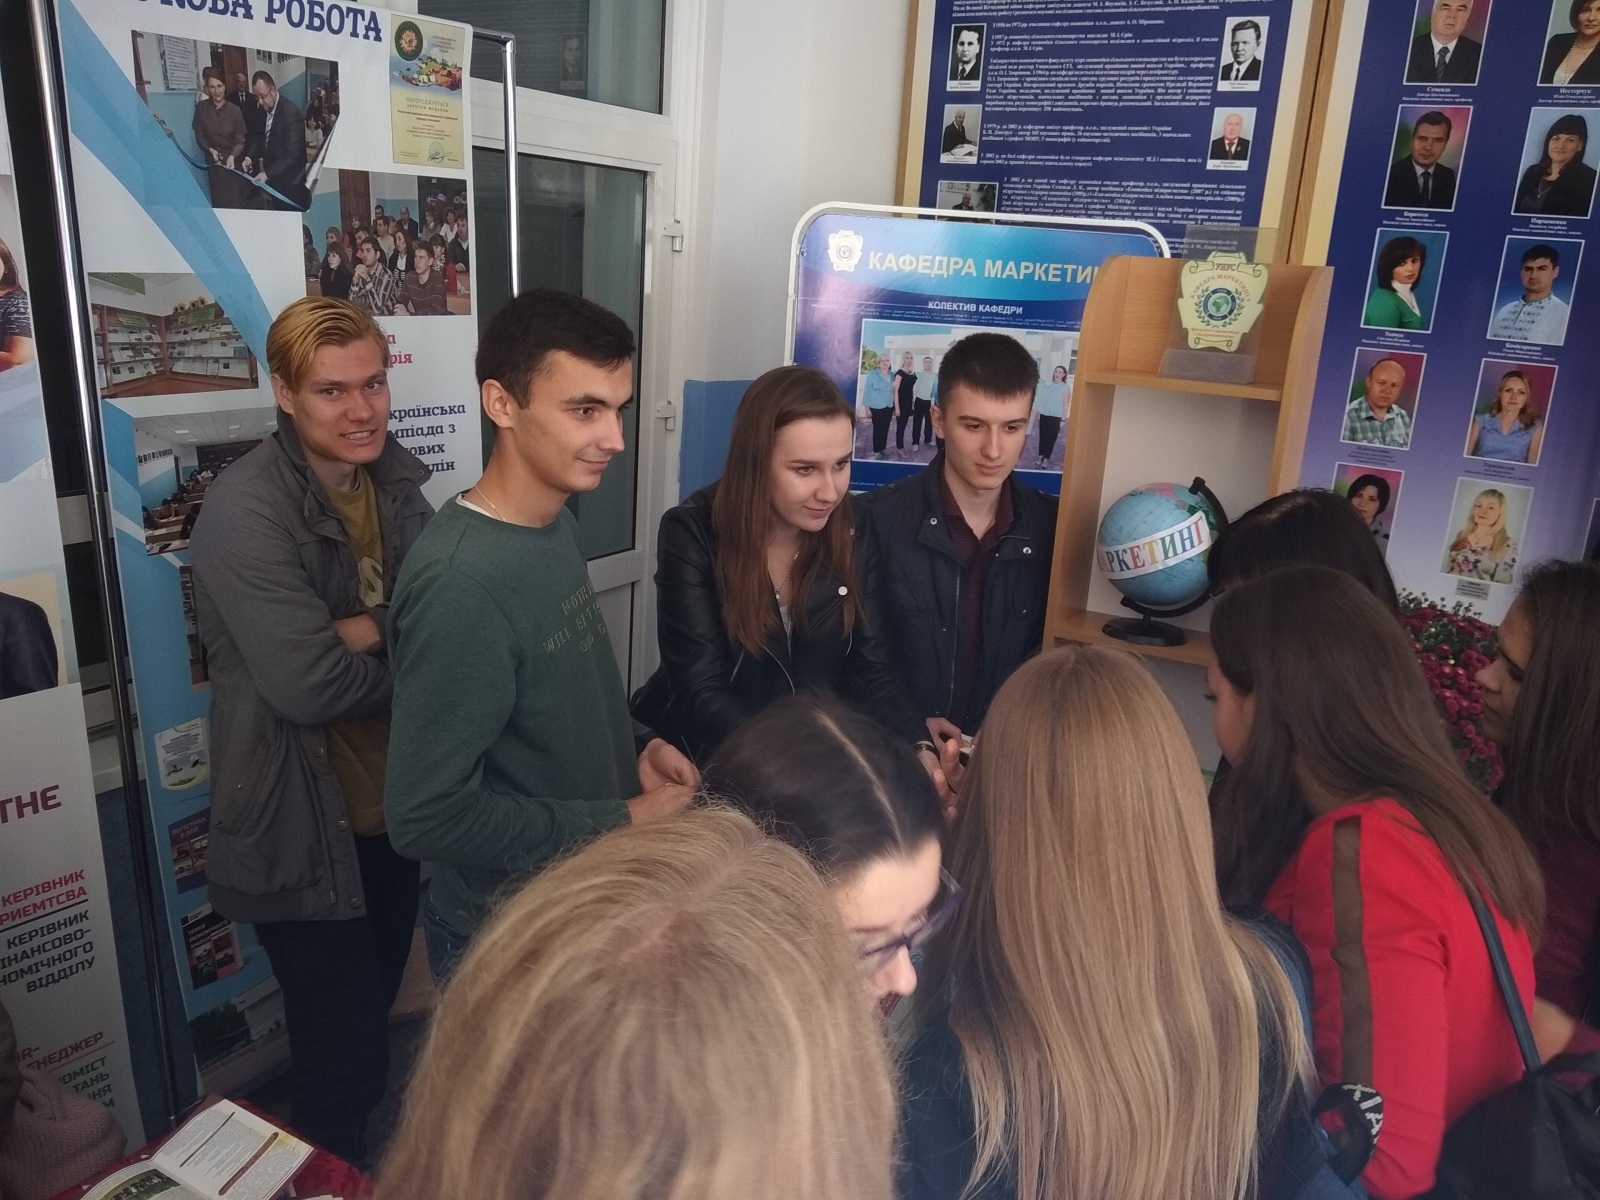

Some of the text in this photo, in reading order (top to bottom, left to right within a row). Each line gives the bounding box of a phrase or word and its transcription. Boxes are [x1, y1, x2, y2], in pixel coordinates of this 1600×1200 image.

[264, 0, 383, 42] РОБОТА
[869, 251, 977, 278] КАФЕДРА
[928, 300, 1023, 315] КОЛЕКТИВ КАФЕДРИ
[389, 350, 413, 368] рія
[389, 404, 466, 423] країнська
[393, 425, 444, 440] мпіада
[406, 443, 445, 457] ових
[1, 869, 85, 908] КЕРІВНИК
[6, 910, 90, 950] КЕРІВНИК
[26, 956, 96, 993] ВІДДІЛУ
[27, 1031, 104, 1070] НЕДЖЕР
[62, 1056, 107, 1085] ОМІСТ
[73, 1073, 109, 1094] ТАНЬ
